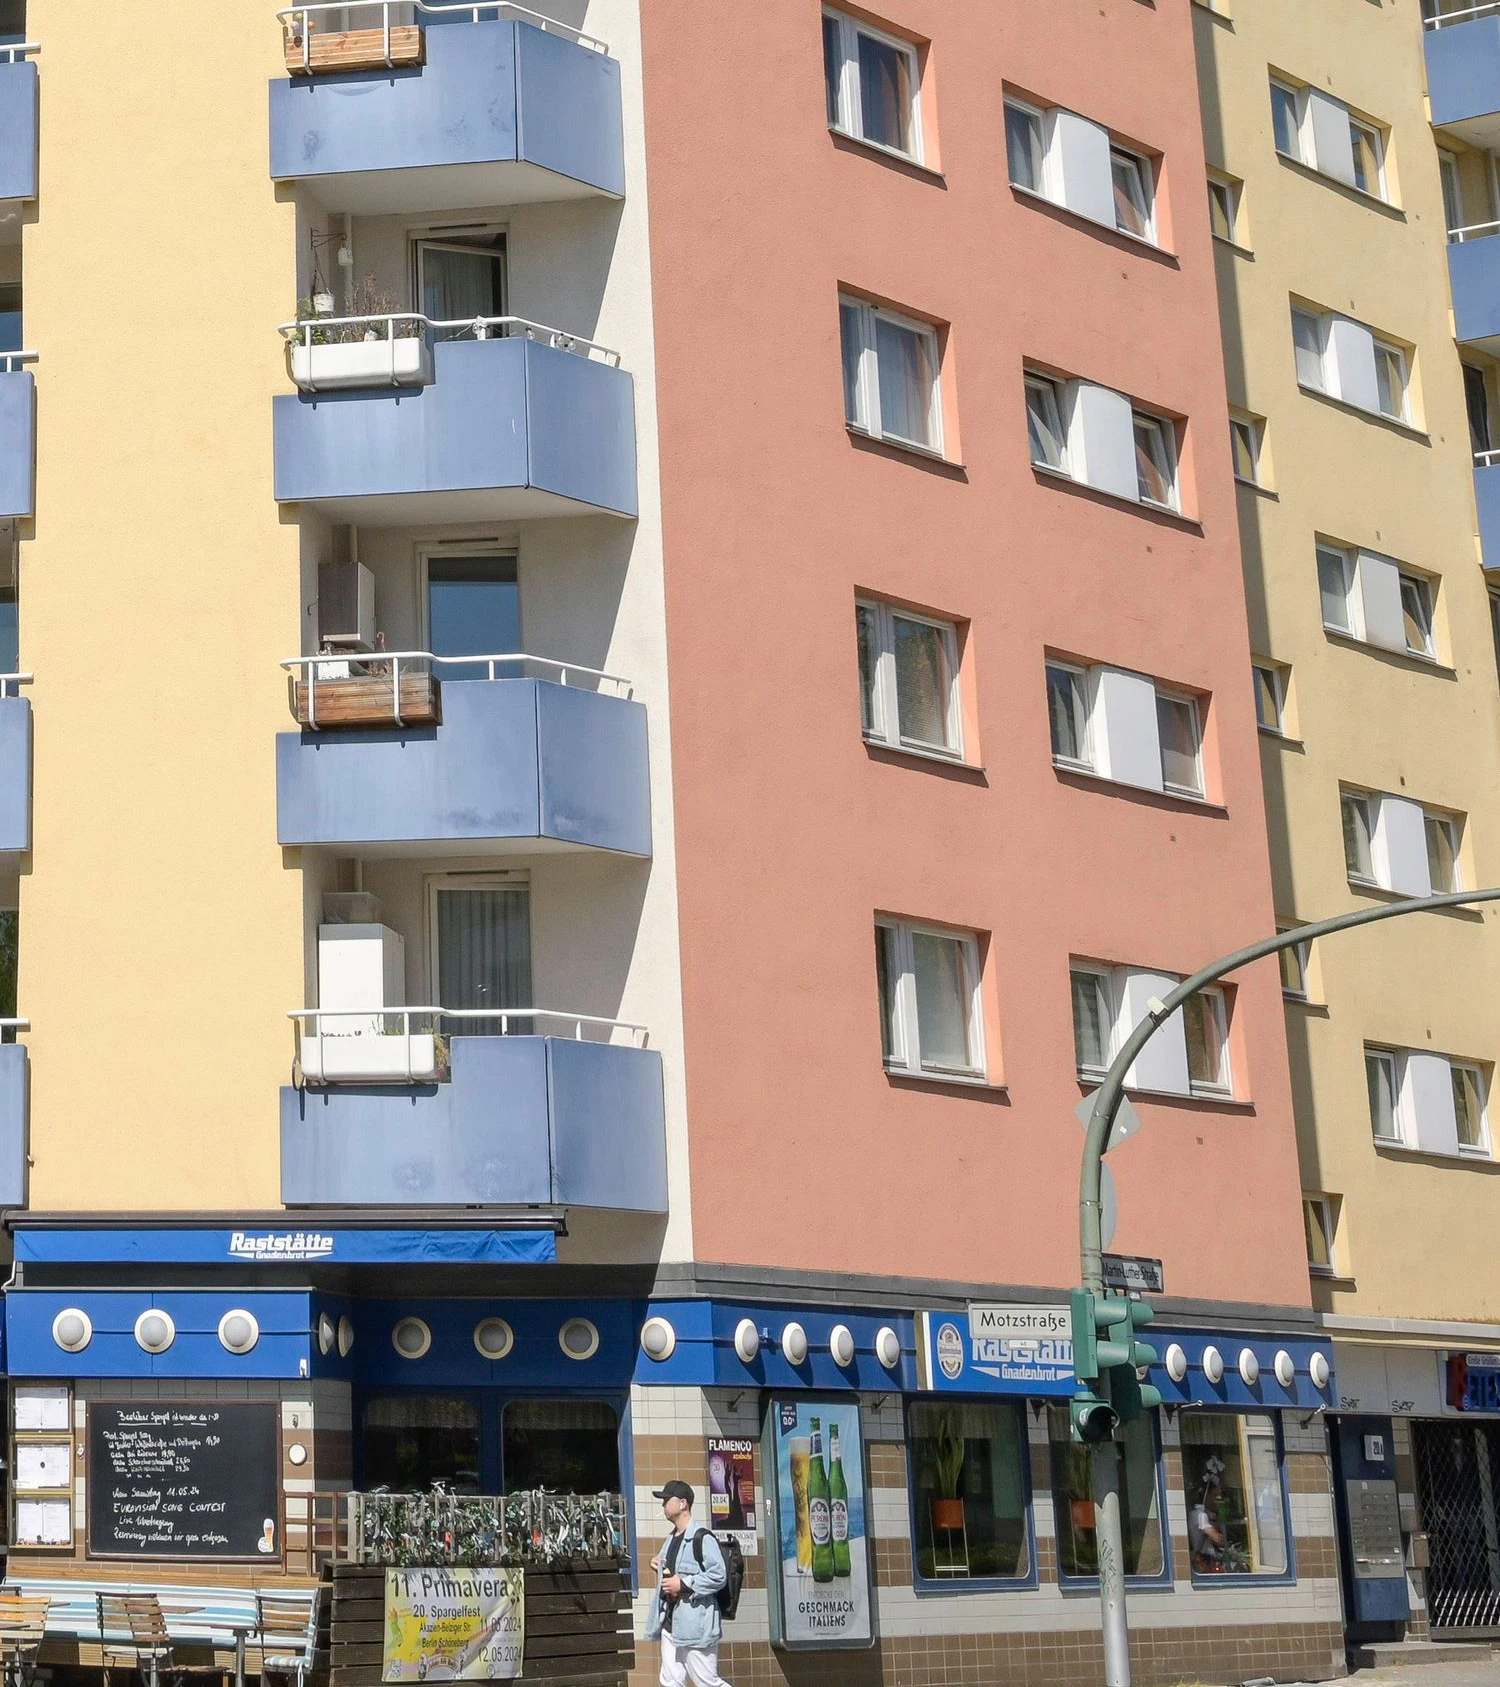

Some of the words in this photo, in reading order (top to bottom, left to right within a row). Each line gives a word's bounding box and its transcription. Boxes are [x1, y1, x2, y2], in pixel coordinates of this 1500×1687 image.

[229, 1232, 334, 1251] Raststätte
[980, 1312, 1067, 1332] Motzstraße
[1001, 1363, 1057, 1381] Gnadenbrot
[708, 1439, 752, 1452] FLAMENCO
[162, 1503, 183, 1512] SONG
[189, 1502, 226, 1513] CONTEST
[391, 1573, 417, 1597] 11.
[421, 1573, 509, 1598] Primavera
[413, 1604, 428, 1617] 20.
[431, 1605, 480, 1620] Spargelfest
[798, 1600, 854, 1613] GESCHMACK
[808, 1614, 846, 1627] ITALIENS
